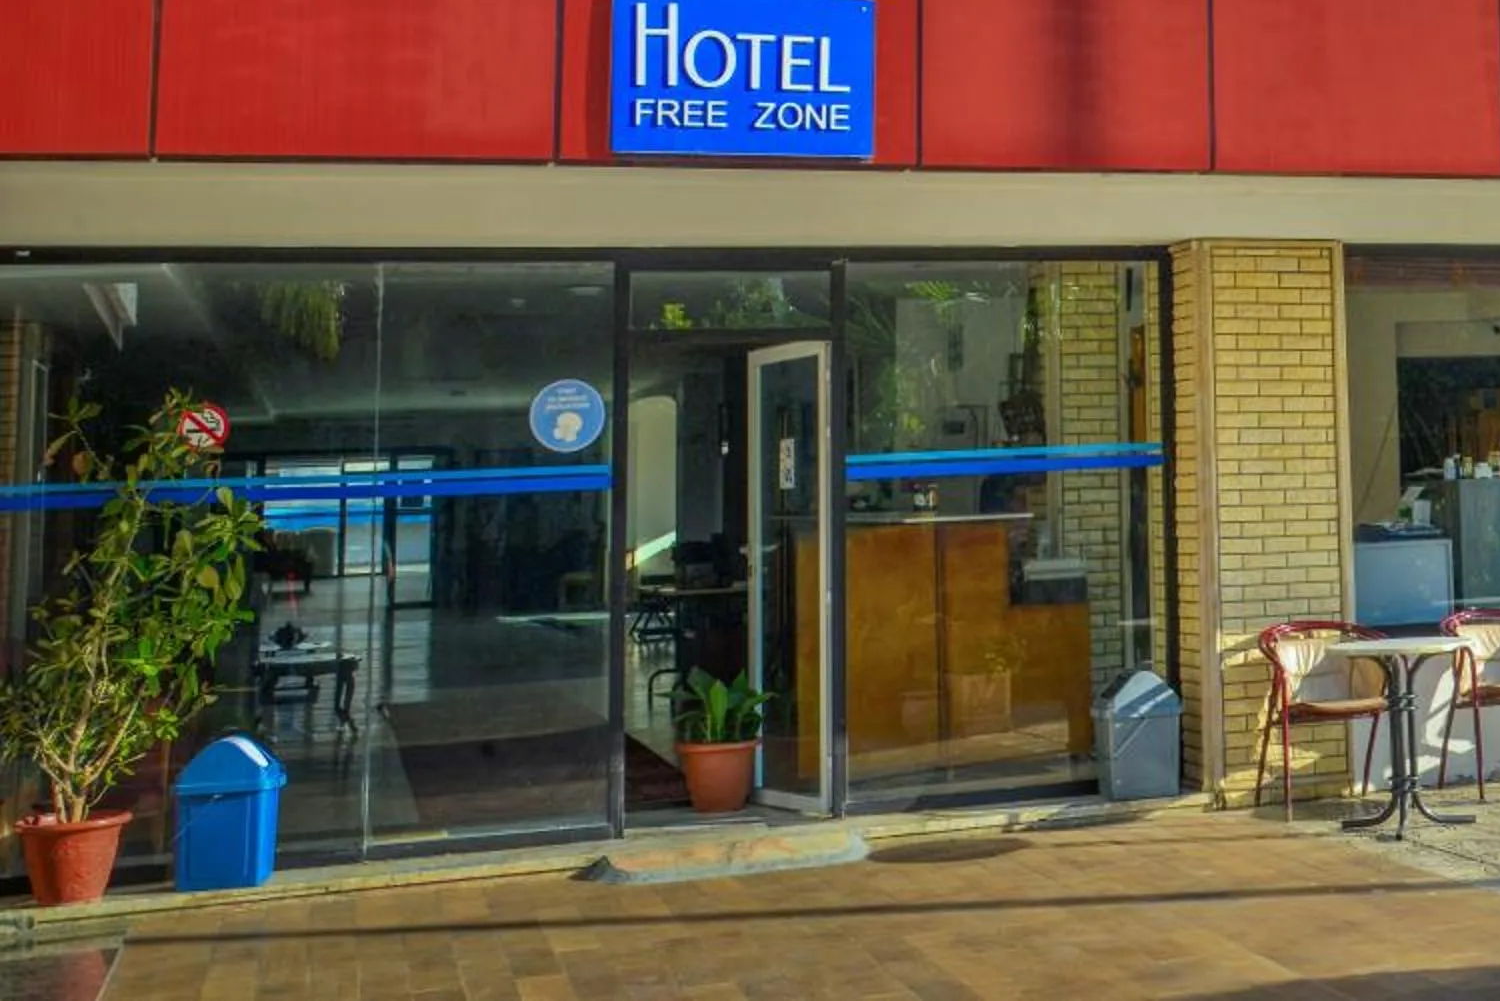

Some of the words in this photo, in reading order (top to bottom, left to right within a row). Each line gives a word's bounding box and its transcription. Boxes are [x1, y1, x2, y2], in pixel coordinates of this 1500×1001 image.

[634, 2, 851, 93] HOTEL
[634, 97, 729, 128] FREE
[753, 101, 851, 131] ZONE
